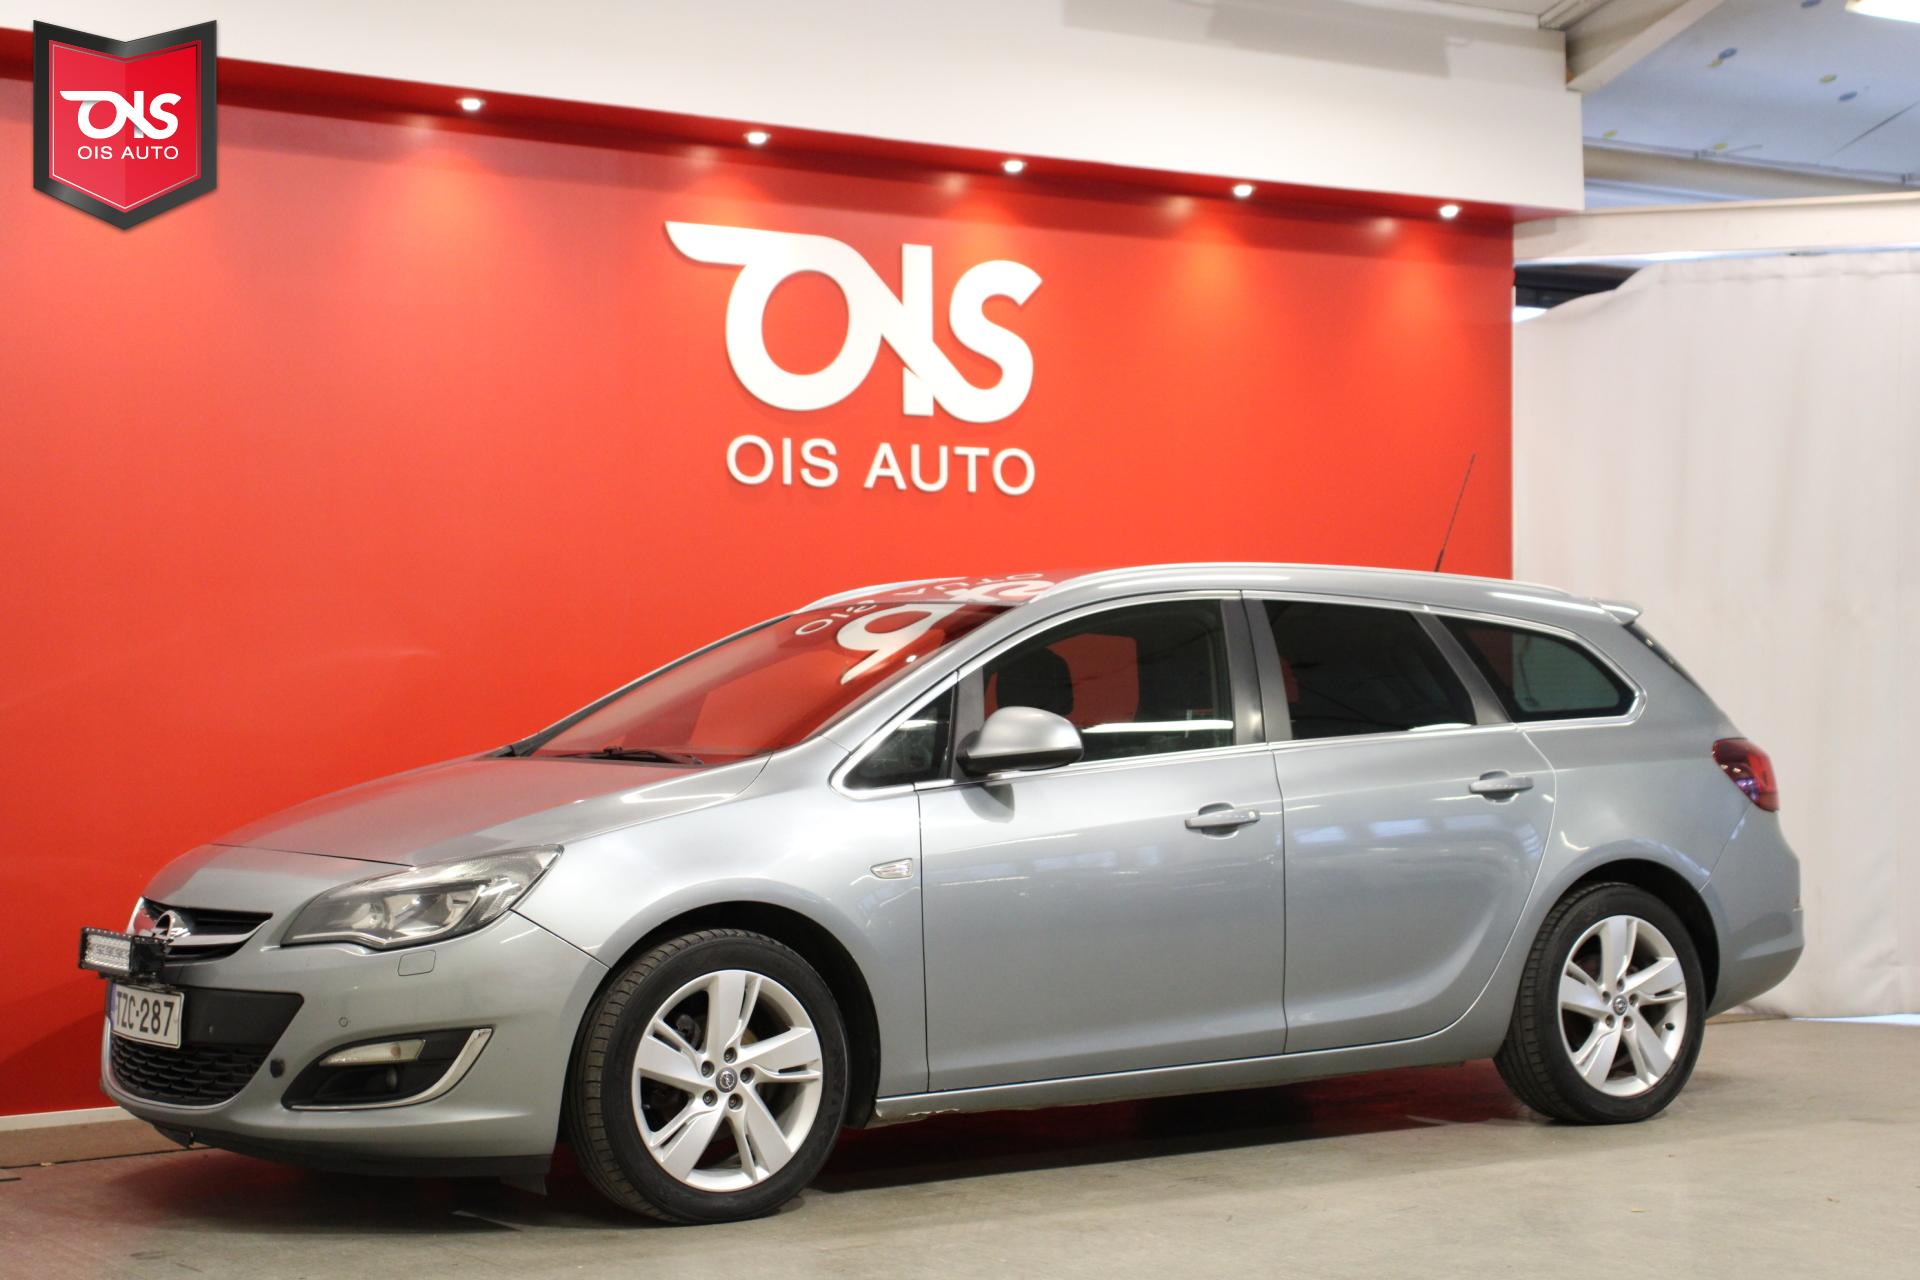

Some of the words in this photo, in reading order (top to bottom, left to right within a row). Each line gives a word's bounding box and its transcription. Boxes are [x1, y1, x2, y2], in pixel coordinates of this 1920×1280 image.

[665, 221, 1043, 423] OIS
[727, 435, 839, 487] OIS
[864, 442, 1035, 496] AUTO
[117, 991, 174, 1036] TZC-287
